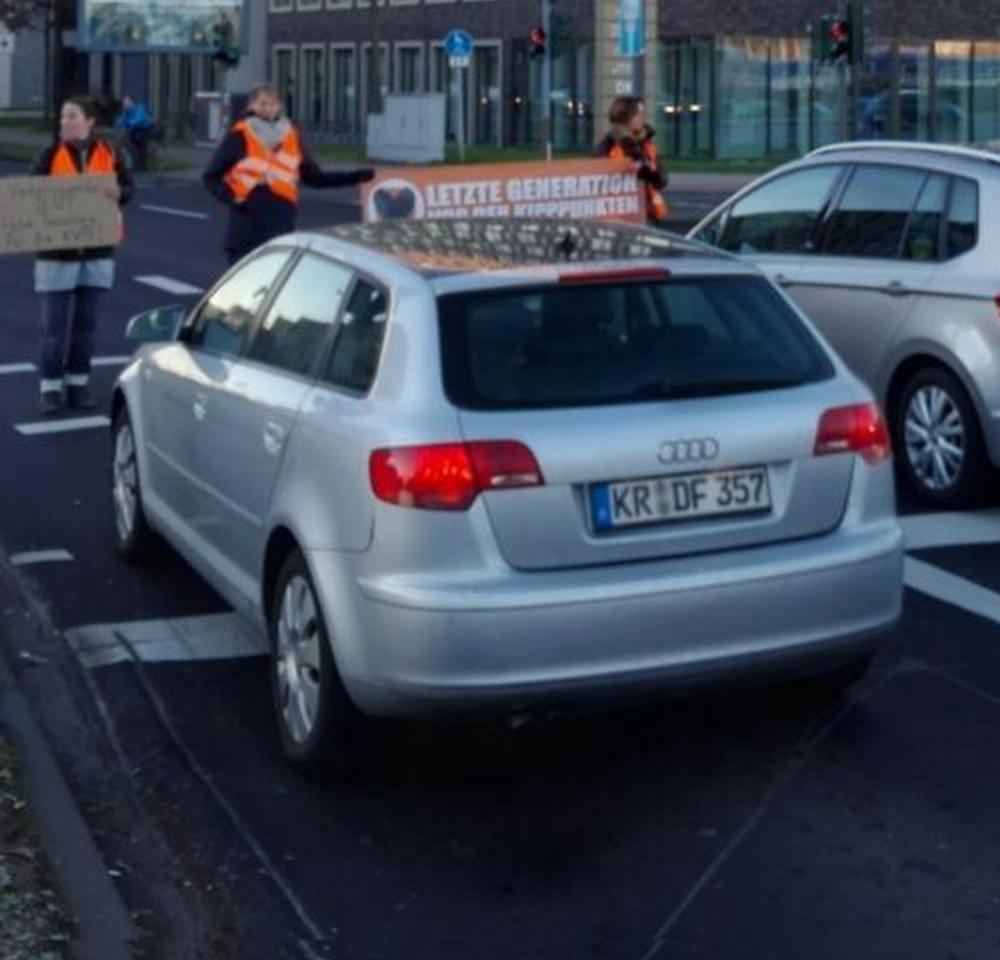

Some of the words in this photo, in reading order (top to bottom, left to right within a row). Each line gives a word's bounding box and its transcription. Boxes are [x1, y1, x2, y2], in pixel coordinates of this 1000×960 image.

[427, 182, 502, 206] LETZTE
[507, 175, 637, 200] GENERATION
[613, 484, 654, 519] KR
[672, 478, 707, 512] DF
[717, 473, 764, 506] 357
